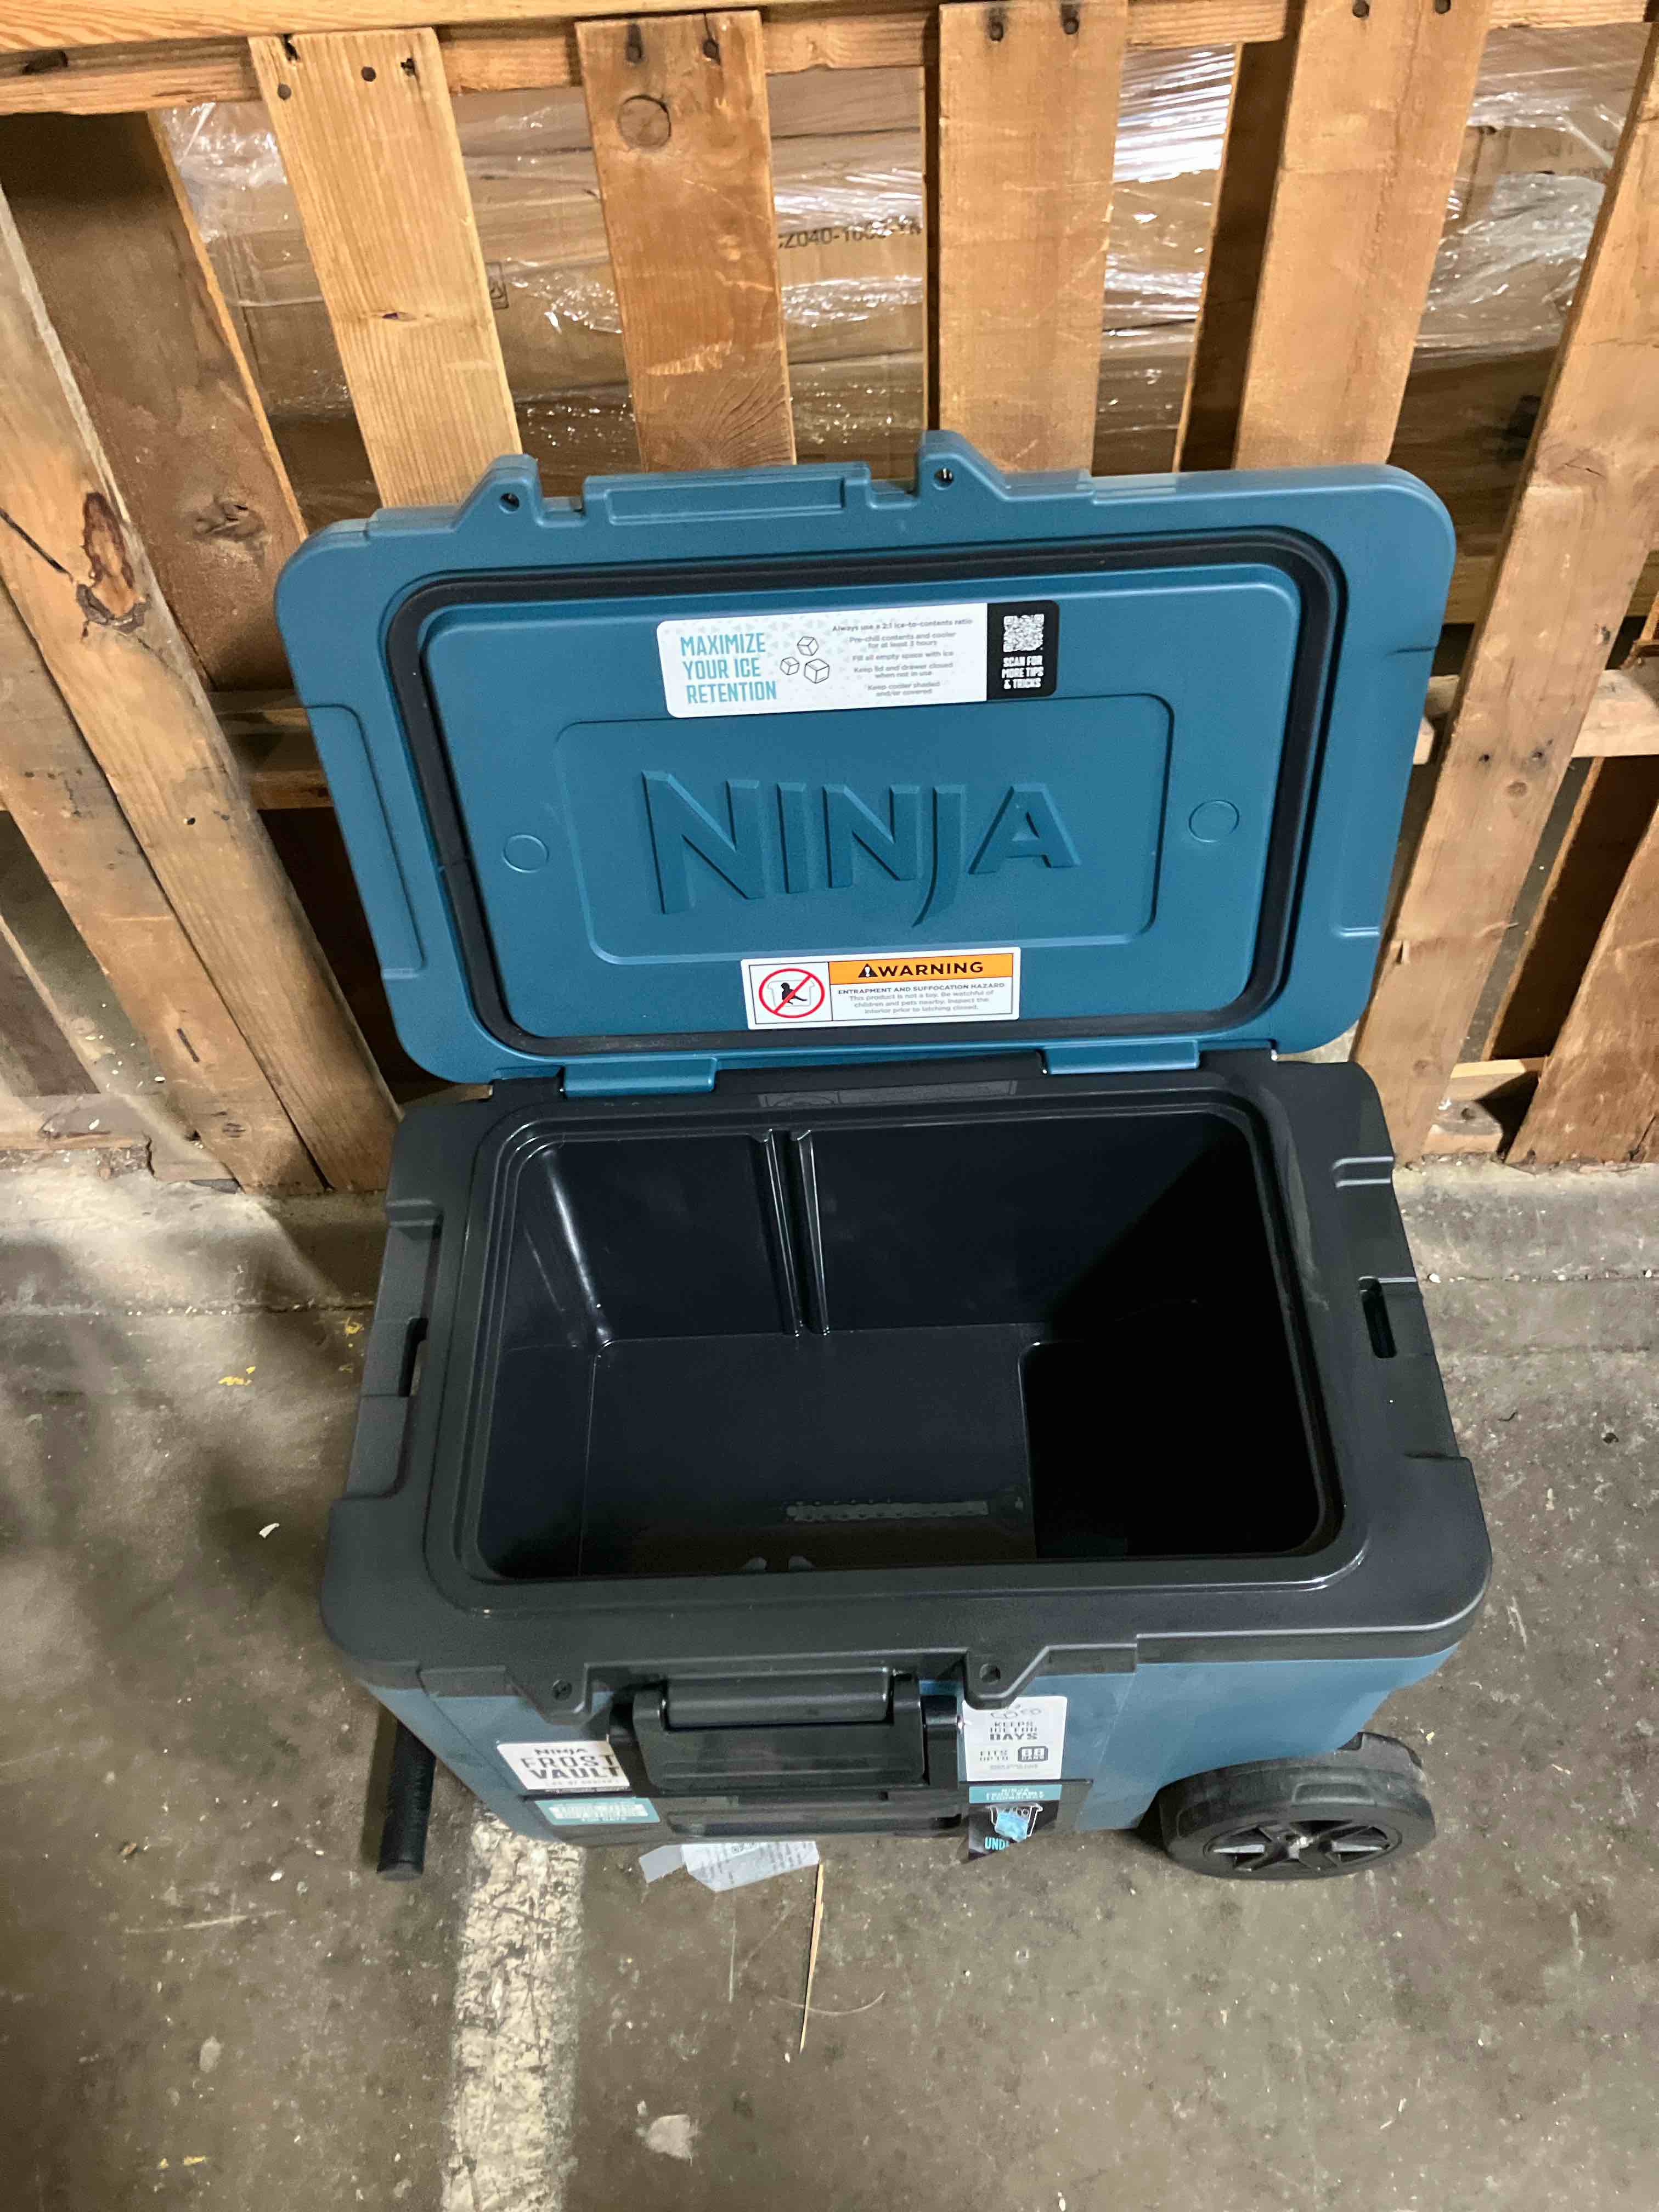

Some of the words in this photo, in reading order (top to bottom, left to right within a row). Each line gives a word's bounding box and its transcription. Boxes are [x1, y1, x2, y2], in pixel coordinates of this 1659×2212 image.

[894, 620, 953, 629] ice-to-contents
[680, 633, 766, 656] MAXIMIZE
[849, 635, 881, 643] Pre-chill
[1003, 656, 1025, 668] SCAN
[1026, 655, 1043, 666] FOR
[683, 658, 729, 680] YOUR
[734, 658, 761, 678] ICE
[1002, 668, 1024, 679] MORE
[1025, 667, 1044, 677] TIPS
[1003, 679, 1012, 690] &
[1013, 678, 1041, 689] TRICKS
[686, 681, 777, 704] RETENTION
[642, 770, 1082, 928] NINJA
[878, 962, 984, 977] WARNING
[520, 1755, 616, 1768] FROST
[529, 1766, 620, 1779] VAULT
